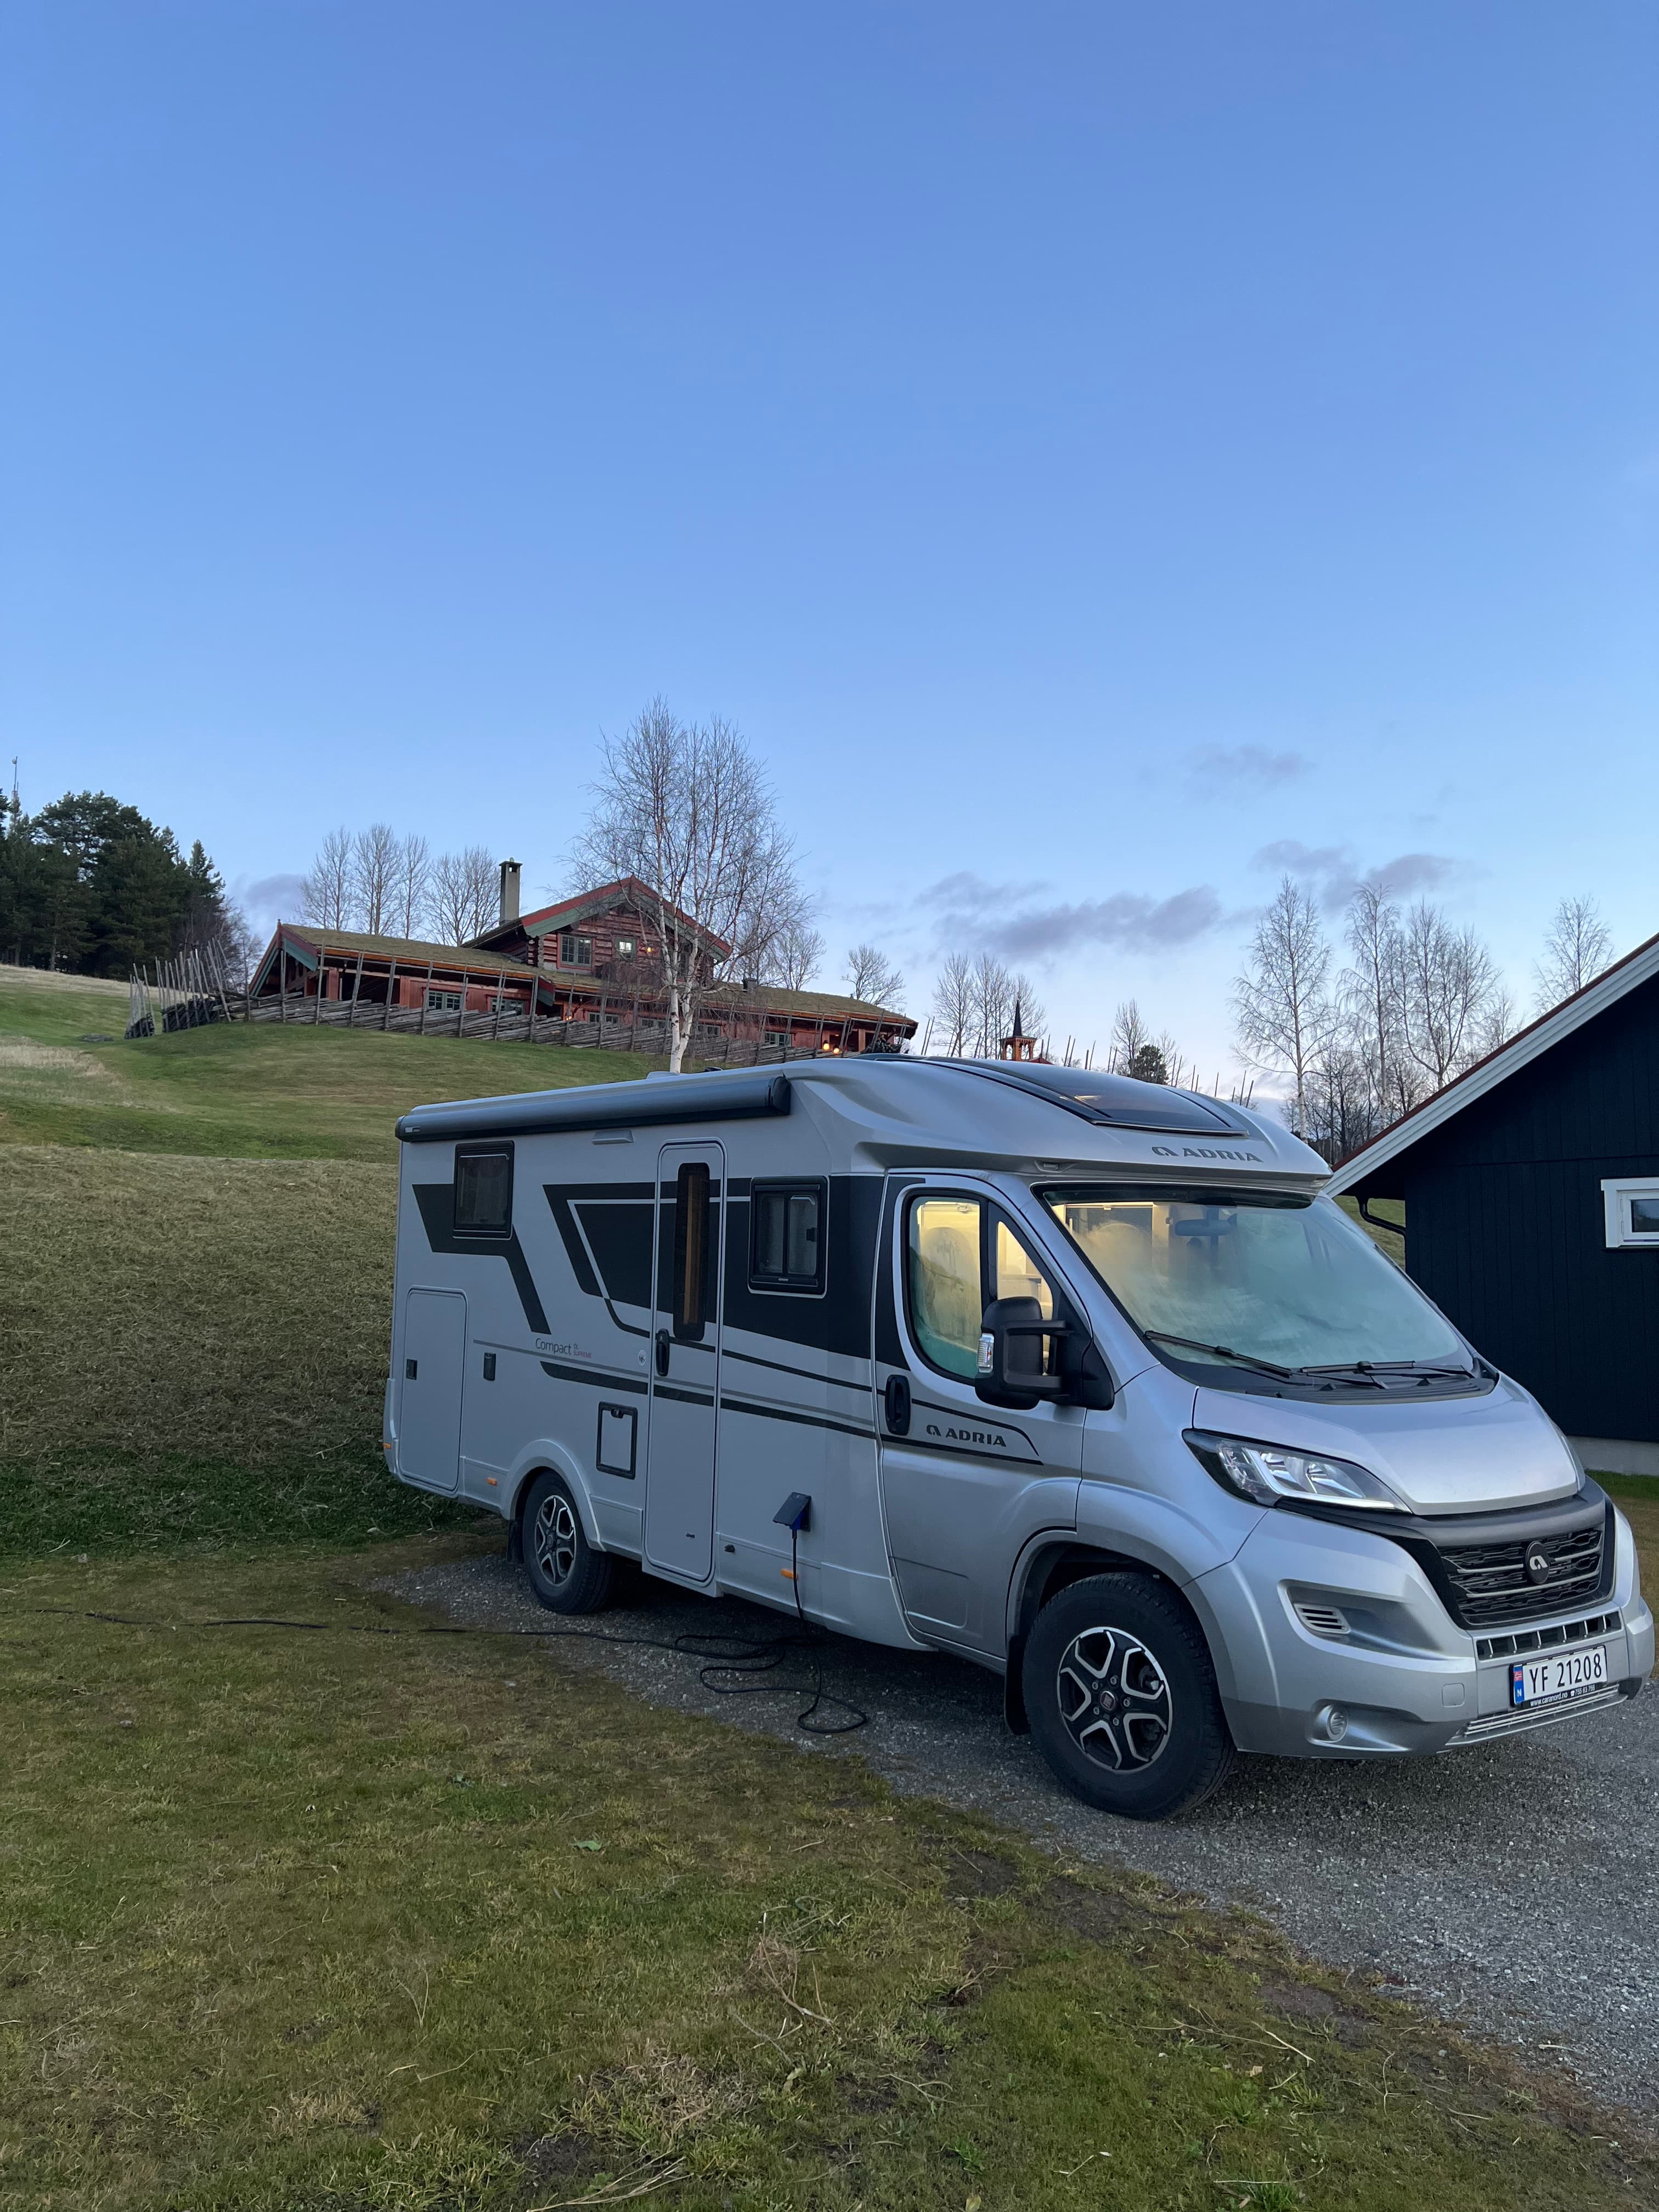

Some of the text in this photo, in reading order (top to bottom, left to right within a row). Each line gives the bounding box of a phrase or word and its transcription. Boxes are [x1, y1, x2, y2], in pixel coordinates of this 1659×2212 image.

[1182, 1147, 1264, 1163] ADRIA
[535, 1338, 572, 1356] Compact
[945, 1427, 1007, 1447] ADRIA
[1529, 1653, 1602, 1694] YF 21208
[1516, 1688, 1522, 1697] N
[1530, 1691, 1568, 1707] www.caranord.no
